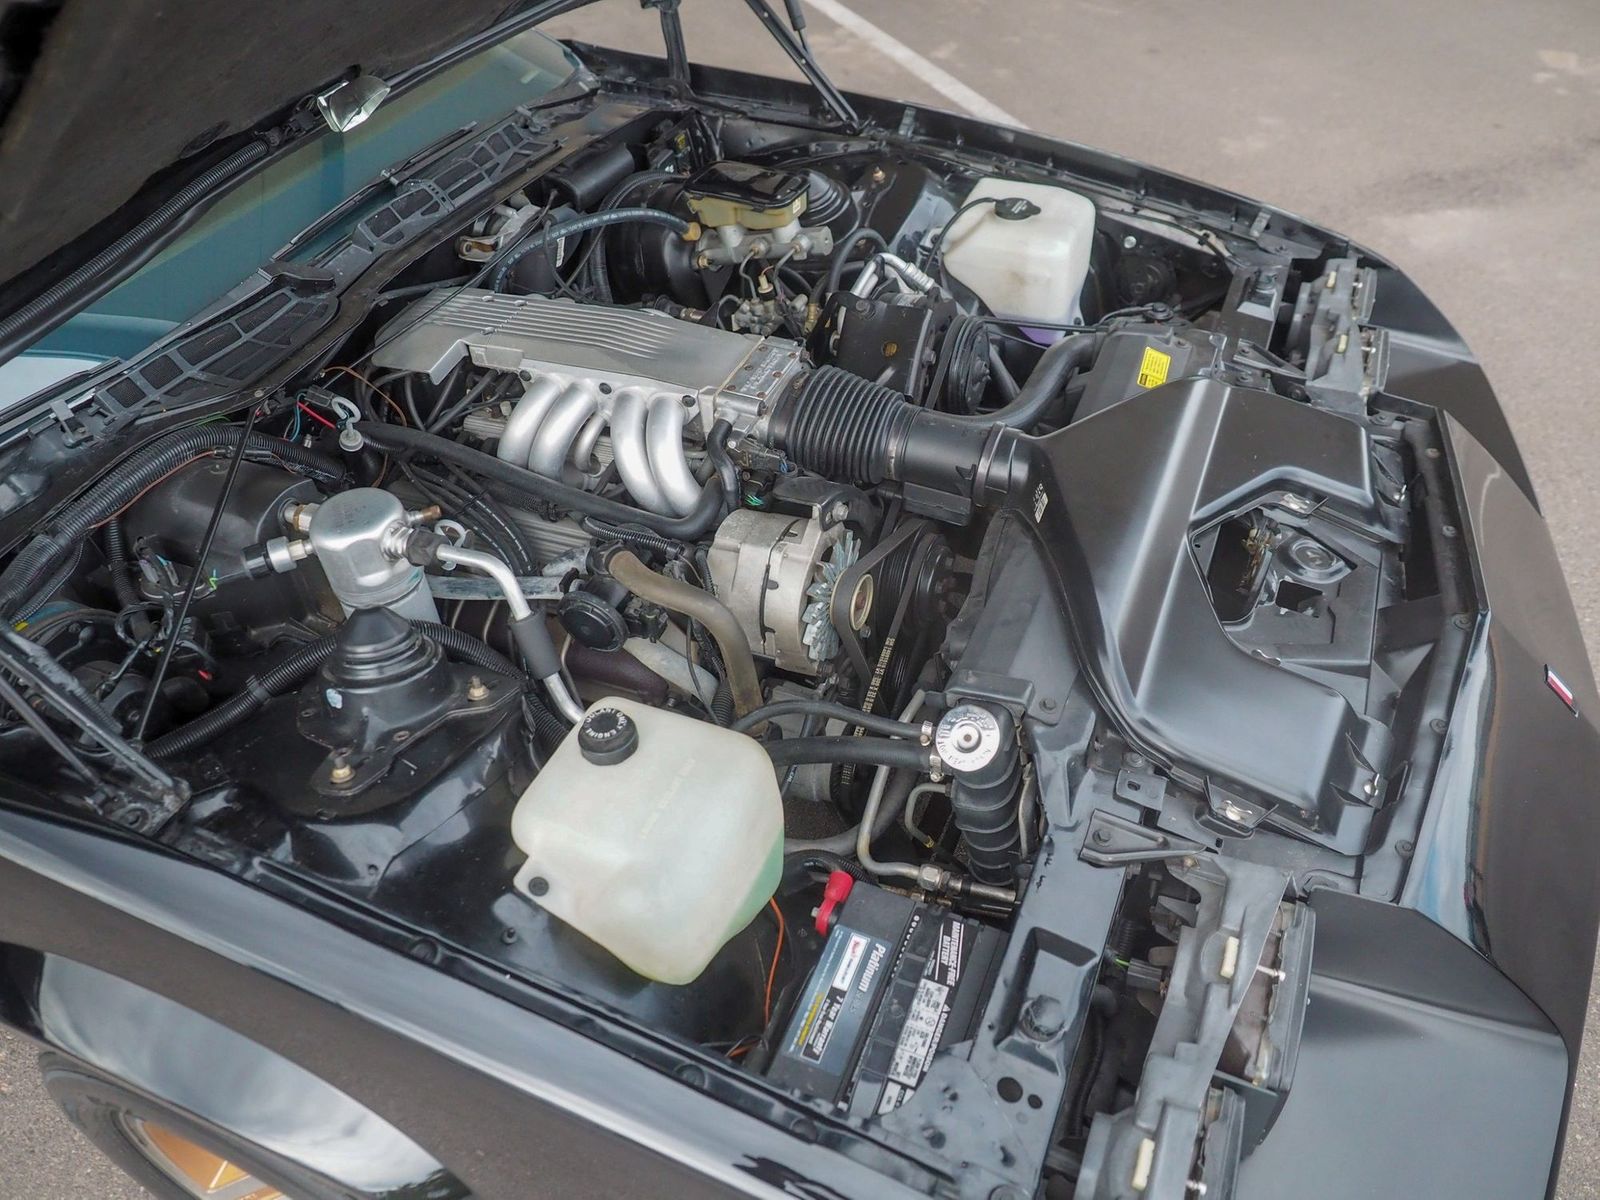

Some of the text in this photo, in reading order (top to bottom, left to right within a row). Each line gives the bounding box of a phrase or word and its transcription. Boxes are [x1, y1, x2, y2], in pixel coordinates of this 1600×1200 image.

[859, 943, 886, 992] Platinum
[941, 935, 951, 966] BATTERY
[947, 920, 960, 987] MAINTENANCE-FREE
[828, 1001, 842, 1019] Year
[813, 1017, 834, 1055] Warranty
